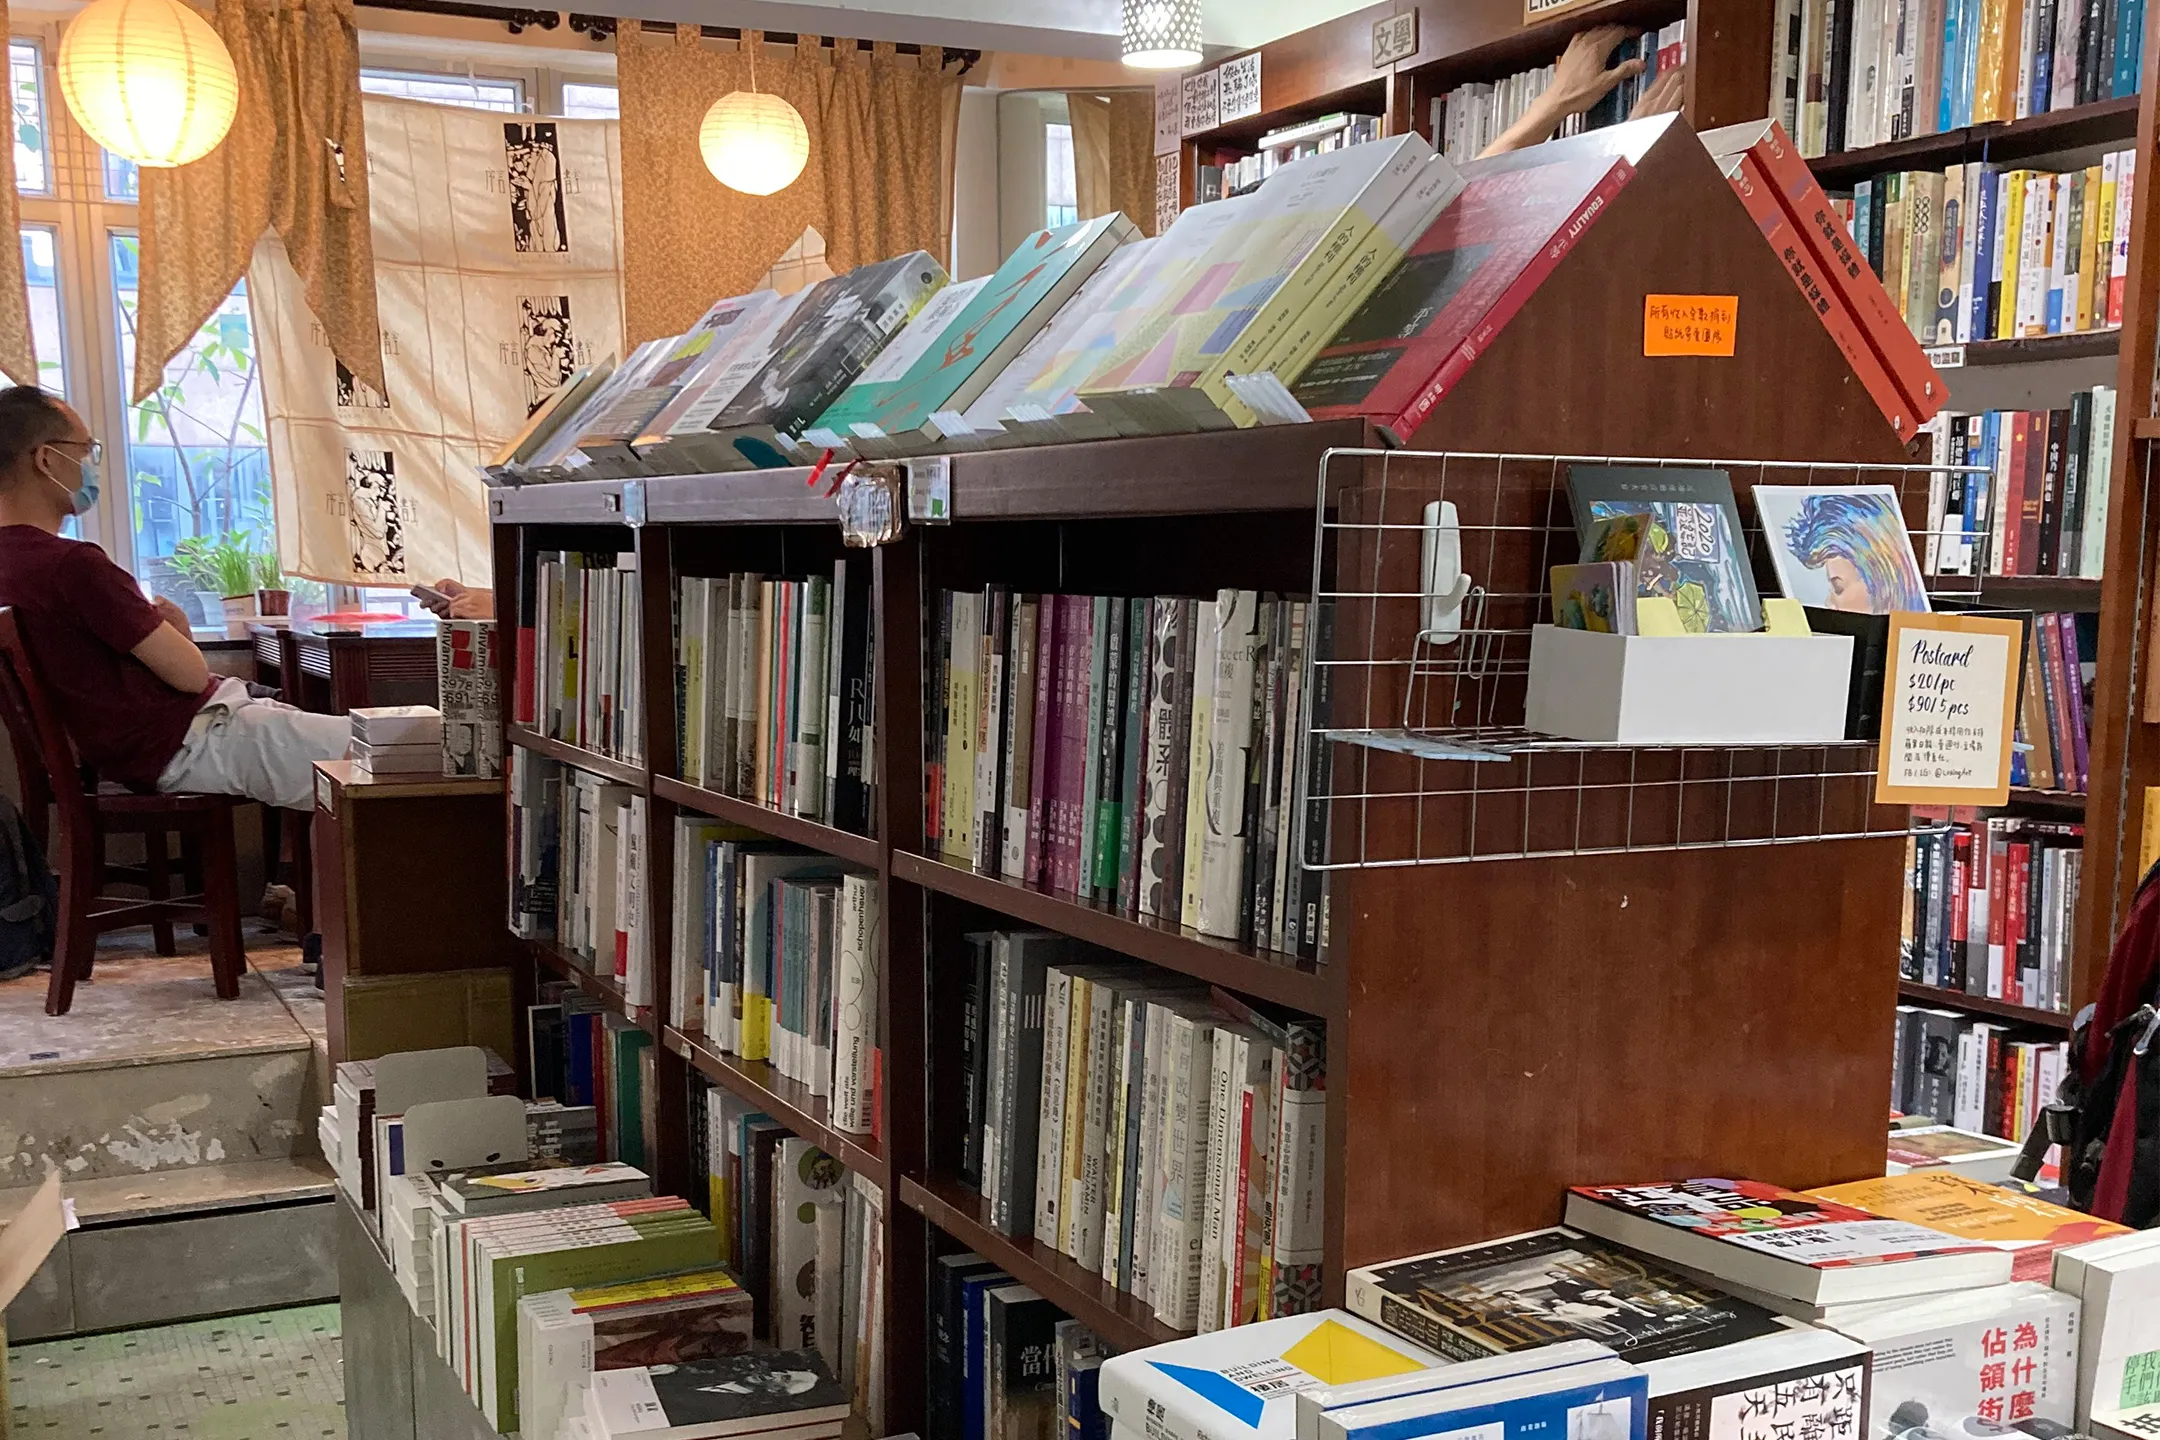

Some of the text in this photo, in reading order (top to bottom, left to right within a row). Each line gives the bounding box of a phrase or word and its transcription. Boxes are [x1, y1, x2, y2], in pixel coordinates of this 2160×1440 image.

[1375, 17, 1411, 60] 文學
[1568, 194, 1604, 240] EQUALITY
[1928, 351, 1960, 365] 勿盜竊
[1696, 507, 1714, 553] 2020
[1910, 639, 1973, 668] Postcard
[1909, 673, 1956, 695] $20/pc
[857, 884, 866, 952] schopenhauer
[1210, 1071, 1229, 1240] One-Dimensional Man
[1083, 1155, 1092, 1215] BENJAMIN
[1089, 1158, 1099, 1204] WALTER
[1219, 1357, 1280, 1374] BUILDING
[1227, 1369, 1253, 1378] AND
[1233, 1365, 1294, 1382] DWELLING
[1976, 1327, 2008, 1424] 佔領街
[2009, 1321, 2038, 1421] 為什麼
[1738, 1372, 1855, 1425] 只有五天
